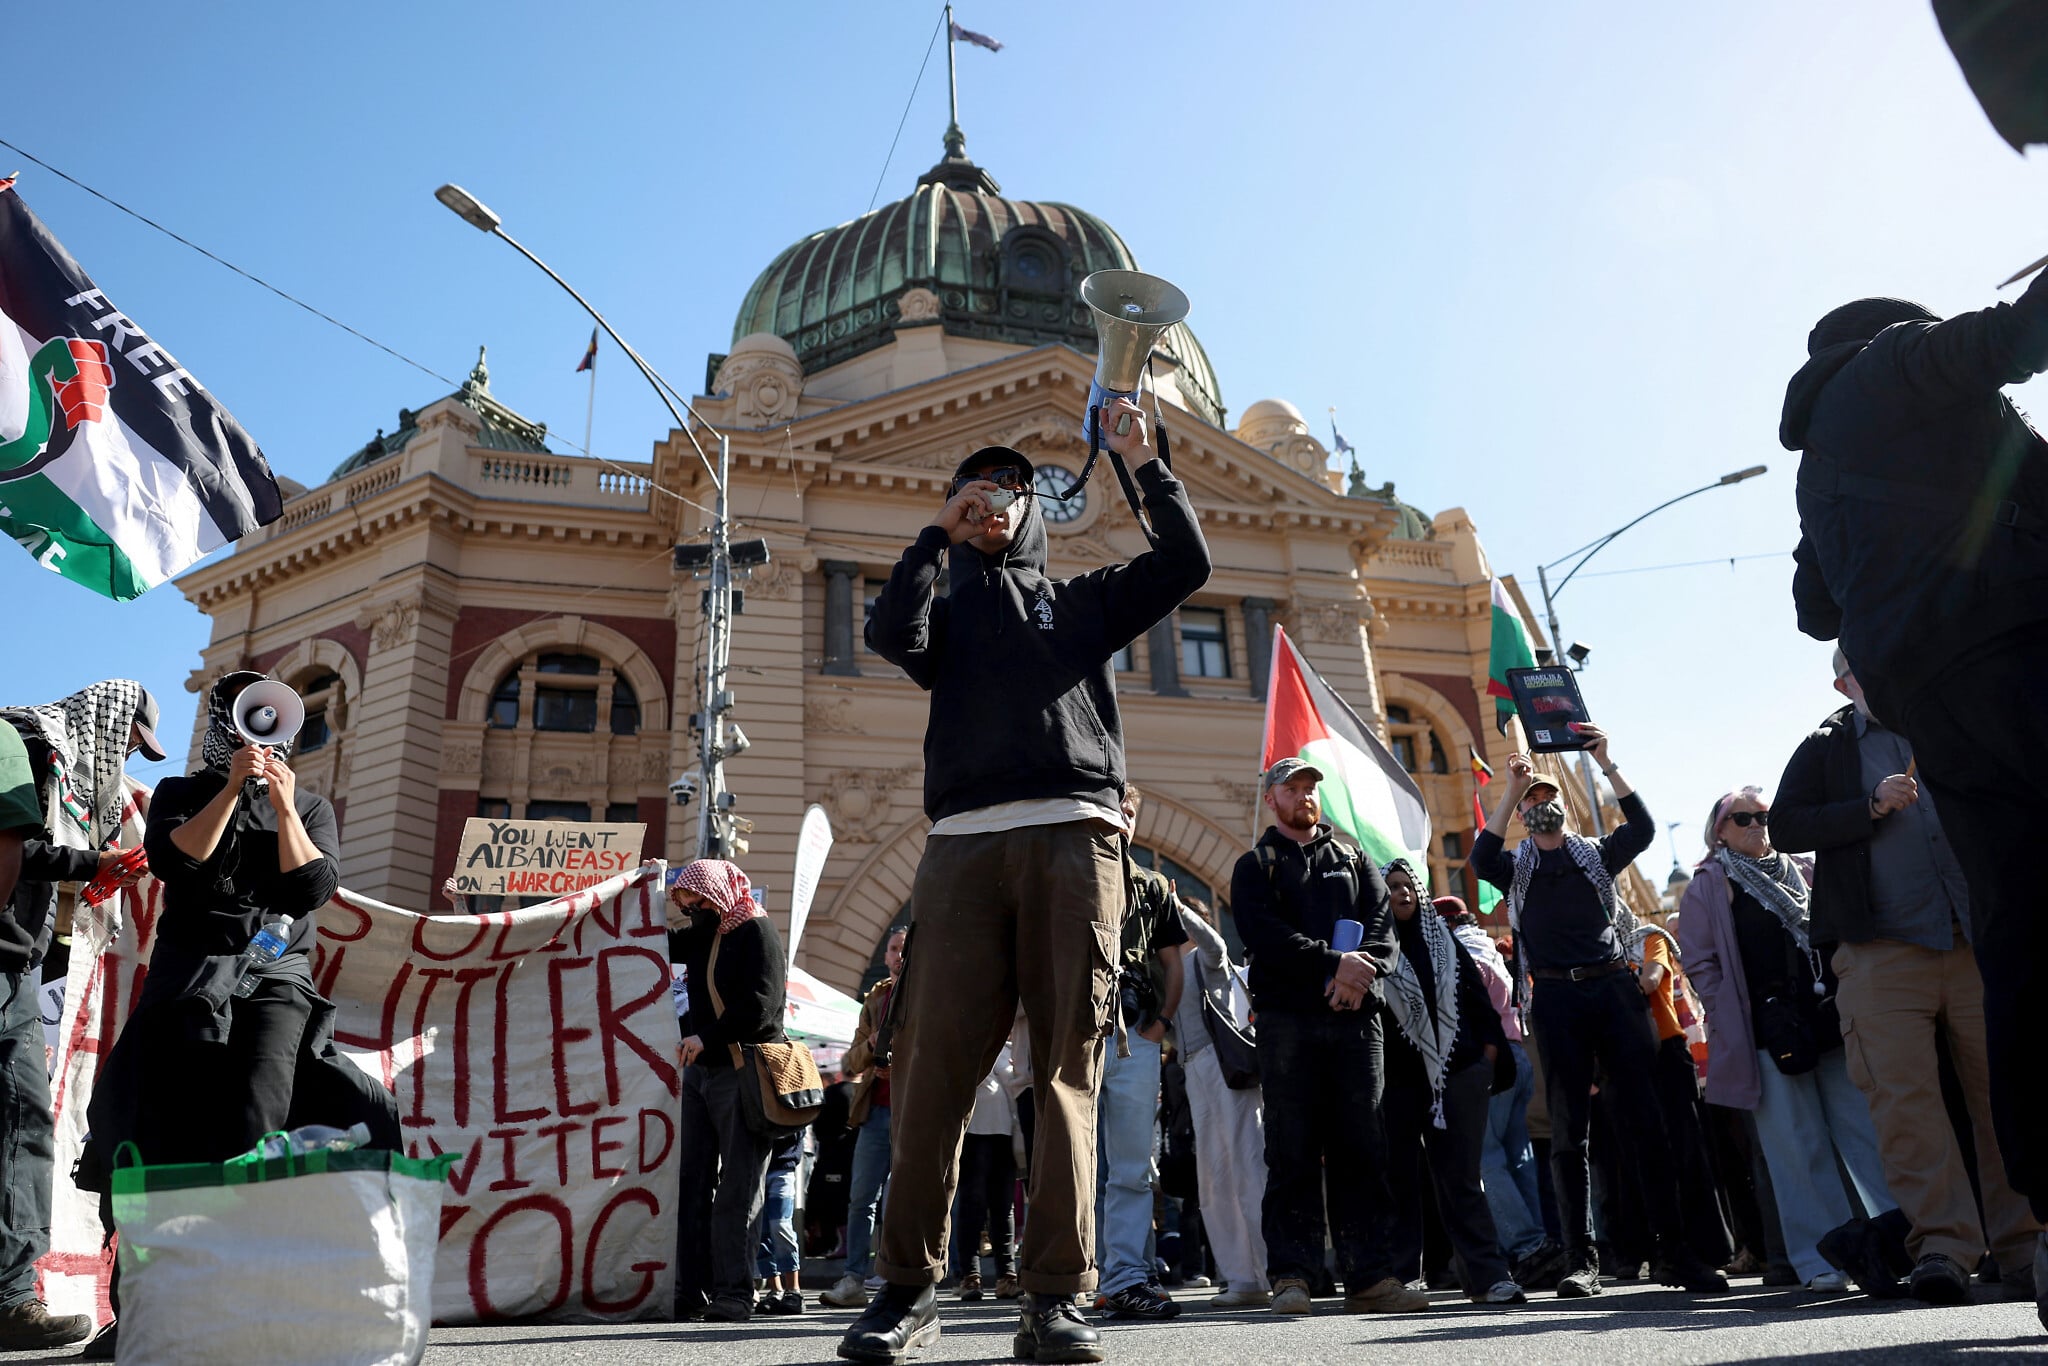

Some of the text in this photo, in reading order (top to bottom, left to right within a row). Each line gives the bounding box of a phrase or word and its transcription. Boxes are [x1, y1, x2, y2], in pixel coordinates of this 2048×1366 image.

[64, 288, 205, 403] FREE
[488, 822, 618, 849] YOU WENT
[466, 843, 632, 870] ALBANEASY
[456, 875, 483, 892] ON
[490, 875, 506, 892] A
